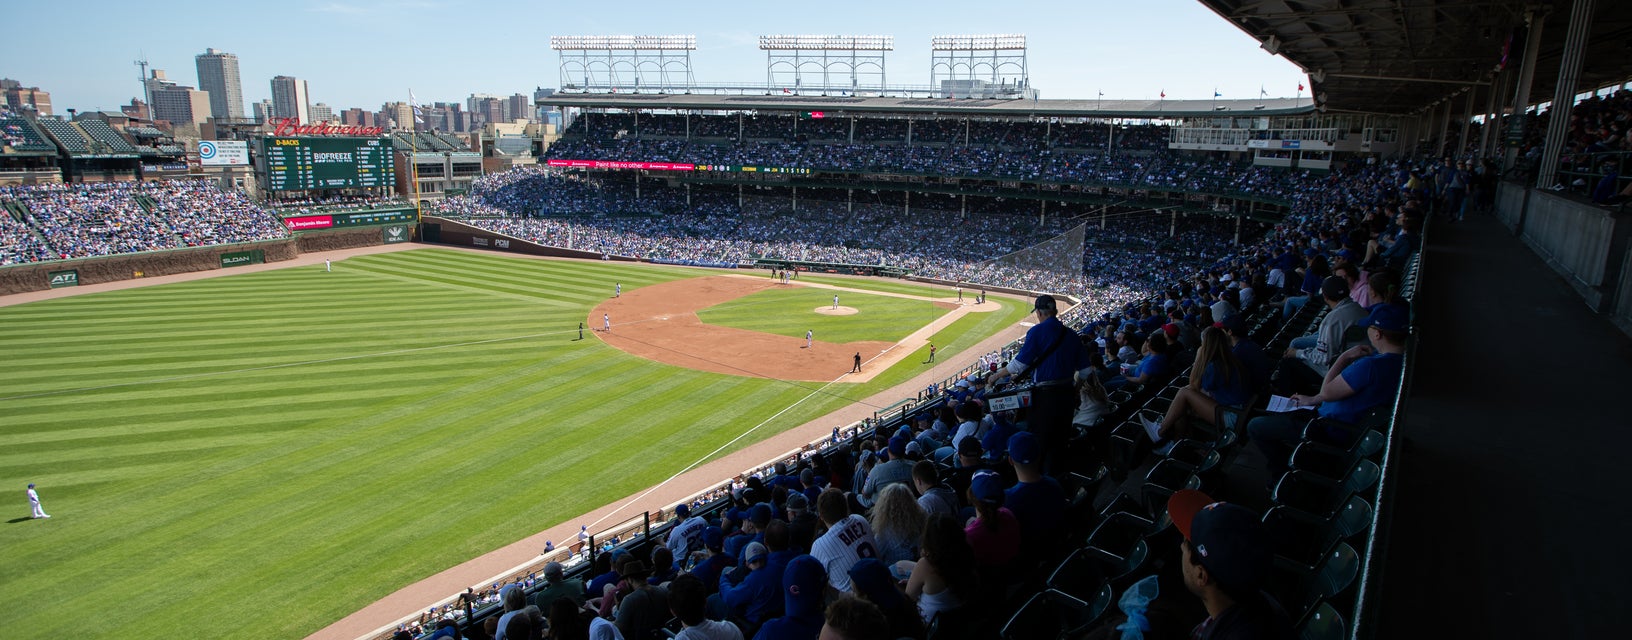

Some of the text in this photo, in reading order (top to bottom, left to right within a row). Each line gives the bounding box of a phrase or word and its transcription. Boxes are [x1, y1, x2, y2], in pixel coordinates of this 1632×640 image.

[268, 117, 384, 136] Budweiser
[313, 152, 353, 160] BIOFREEZE
[51, 273, 77, 283] ATI
